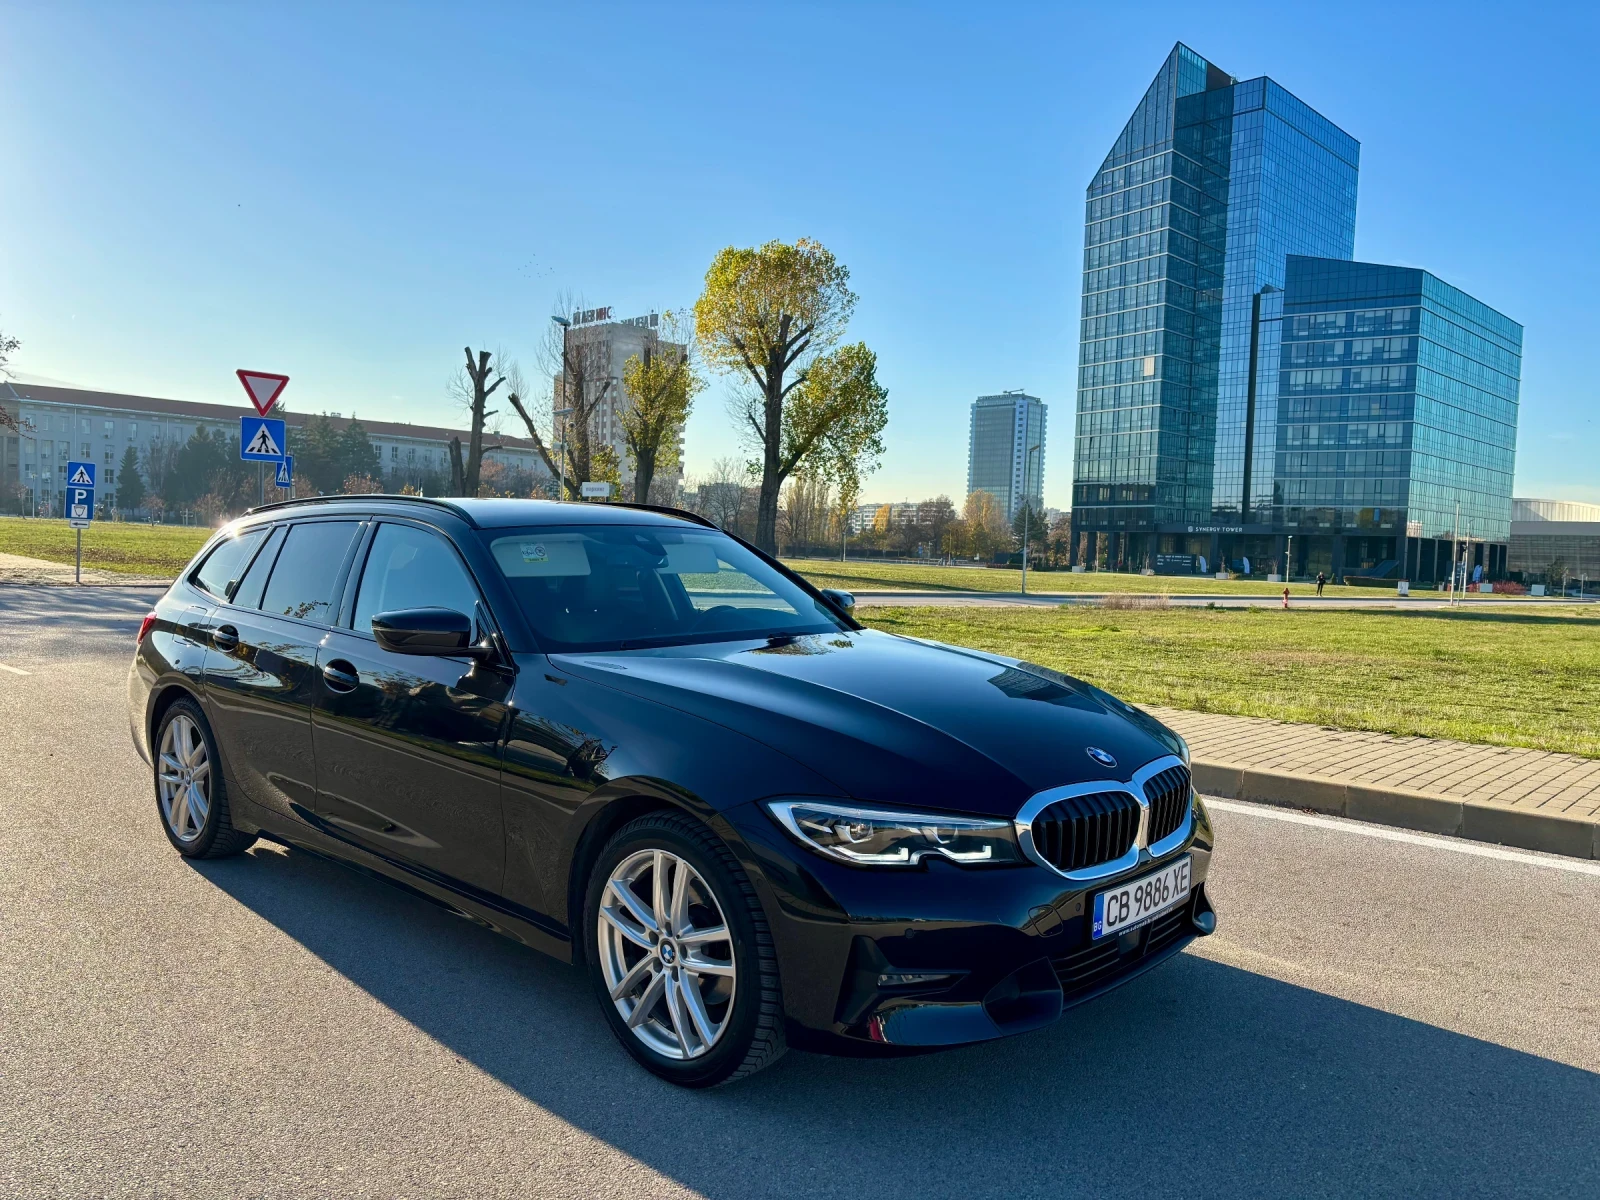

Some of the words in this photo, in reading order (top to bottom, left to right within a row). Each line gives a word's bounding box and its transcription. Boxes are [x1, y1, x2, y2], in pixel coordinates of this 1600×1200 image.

[74, 489, 87, 504] P
[1106, 890, 1130, 927] CB
[1134, 872, 1170, 918] 9886
[1171, 861, 1189, 899] XE
[1093, 920, 1103, 932] BG
